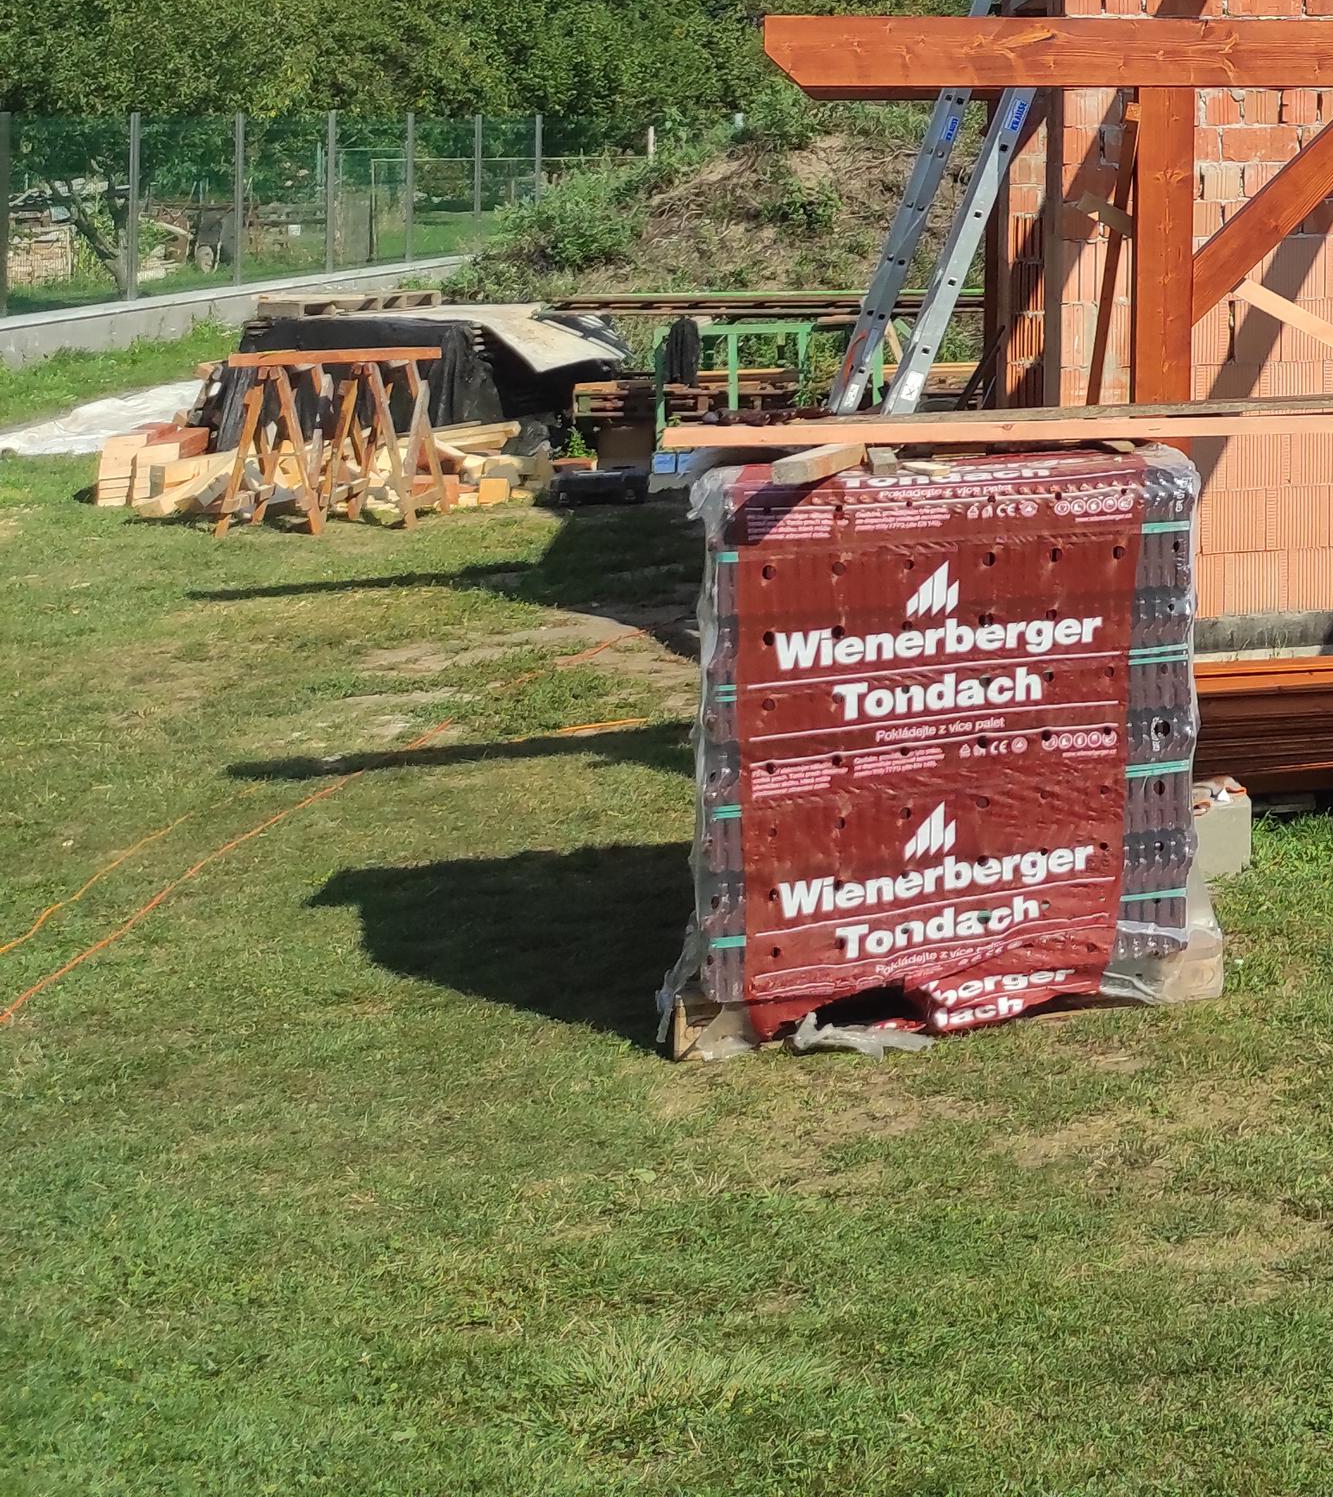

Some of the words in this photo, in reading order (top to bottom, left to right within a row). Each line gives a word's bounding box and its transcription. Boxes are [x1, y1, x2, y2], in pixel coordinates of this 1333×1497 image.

[1010, 102, 1027, 131] KRAUSE
[774, 617, 1103, 671] Wienerberger
[833, 667, 1042, 721] Tondach
[875, 725, 937, 743] Pokládejte
[937, 726, 947, 734] z
[948, 721, 973, 734] více
[975, 716, 1006, 733] palet
[778, 844, 1095, 919] Wienerberger
[836, 896, 1040, 959] Tondach
